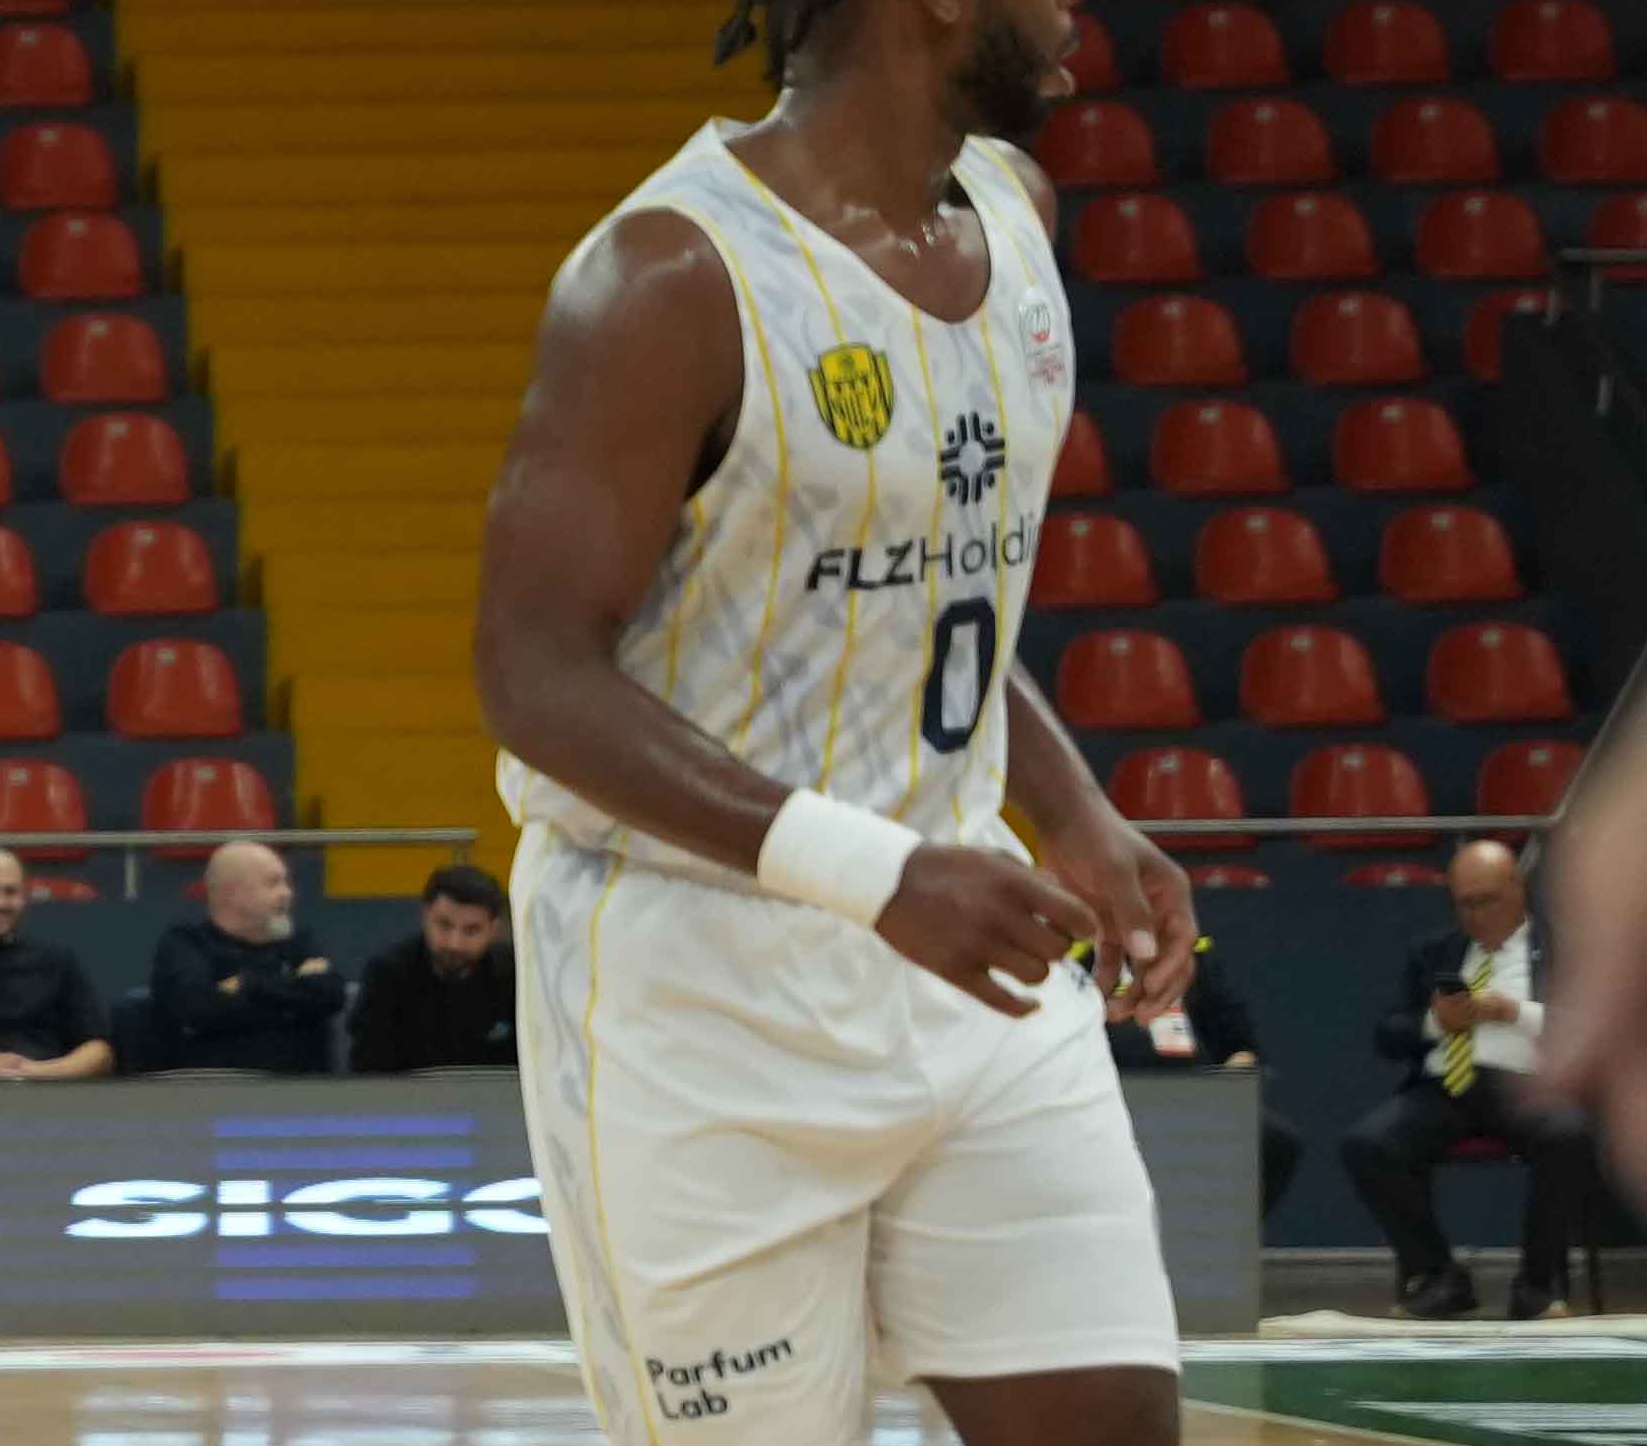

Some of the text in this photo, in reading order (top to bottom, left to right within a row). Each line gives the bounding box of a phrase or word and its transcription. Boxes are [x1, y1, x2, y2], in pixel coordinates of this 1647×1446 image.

[922, 596, 997, 754] 0
[645, 1337, 794, 1390] Parfum
[658, 1393, 729, 1422] Lab
